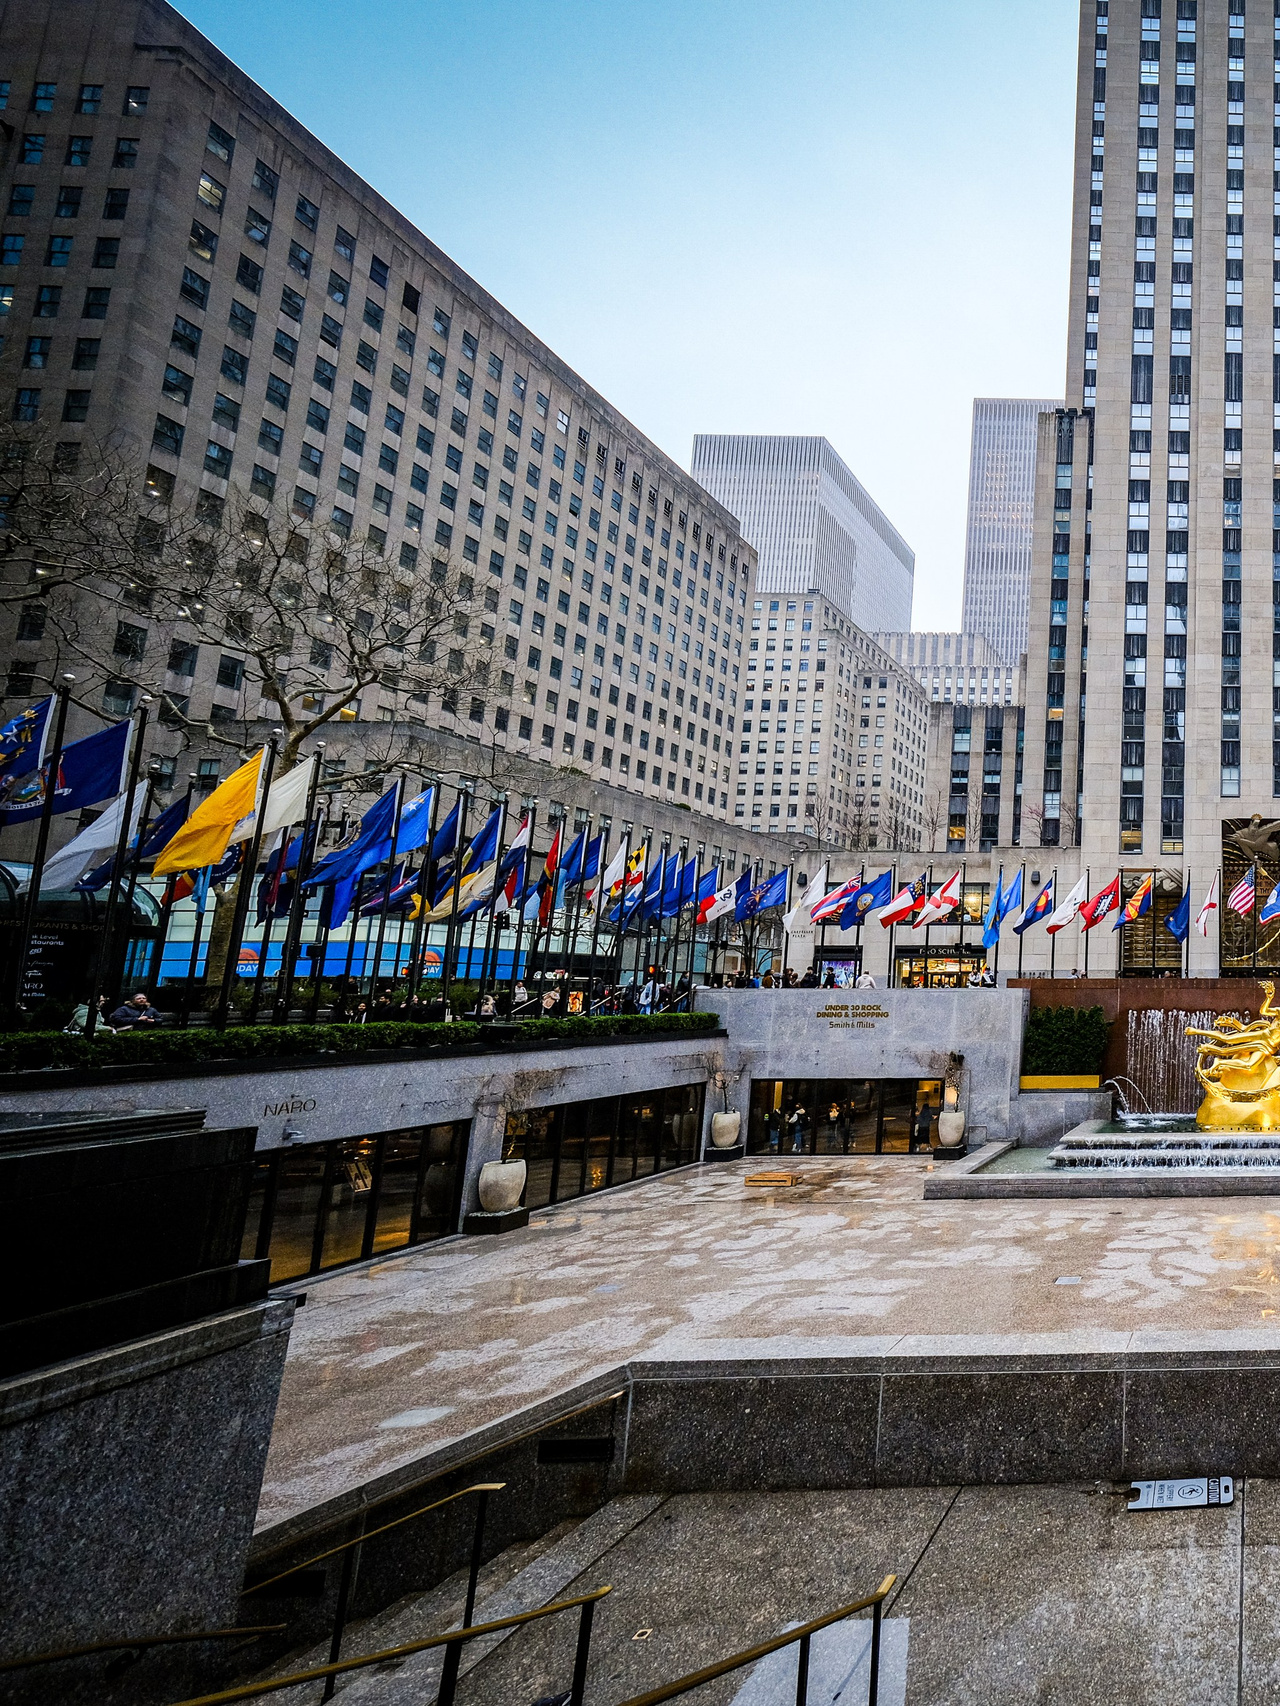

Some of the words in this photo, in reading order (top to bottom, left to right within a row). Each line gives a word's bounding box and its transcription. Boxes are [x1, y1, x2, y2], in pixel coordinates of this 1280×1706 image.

[829, 1020, 850, 1029] Smith
[856, 1021, 875, 1029] Mills
[263, 1098, 317, 1117] NARO
[1158, 1484, 1166, 1494] WHEN
[1166, 1484, 1175, 1502] SLIPPERY
[1208, 1478, 1220, 1504] CAUTION
[1156, 1495, 1164, 1504] WET
